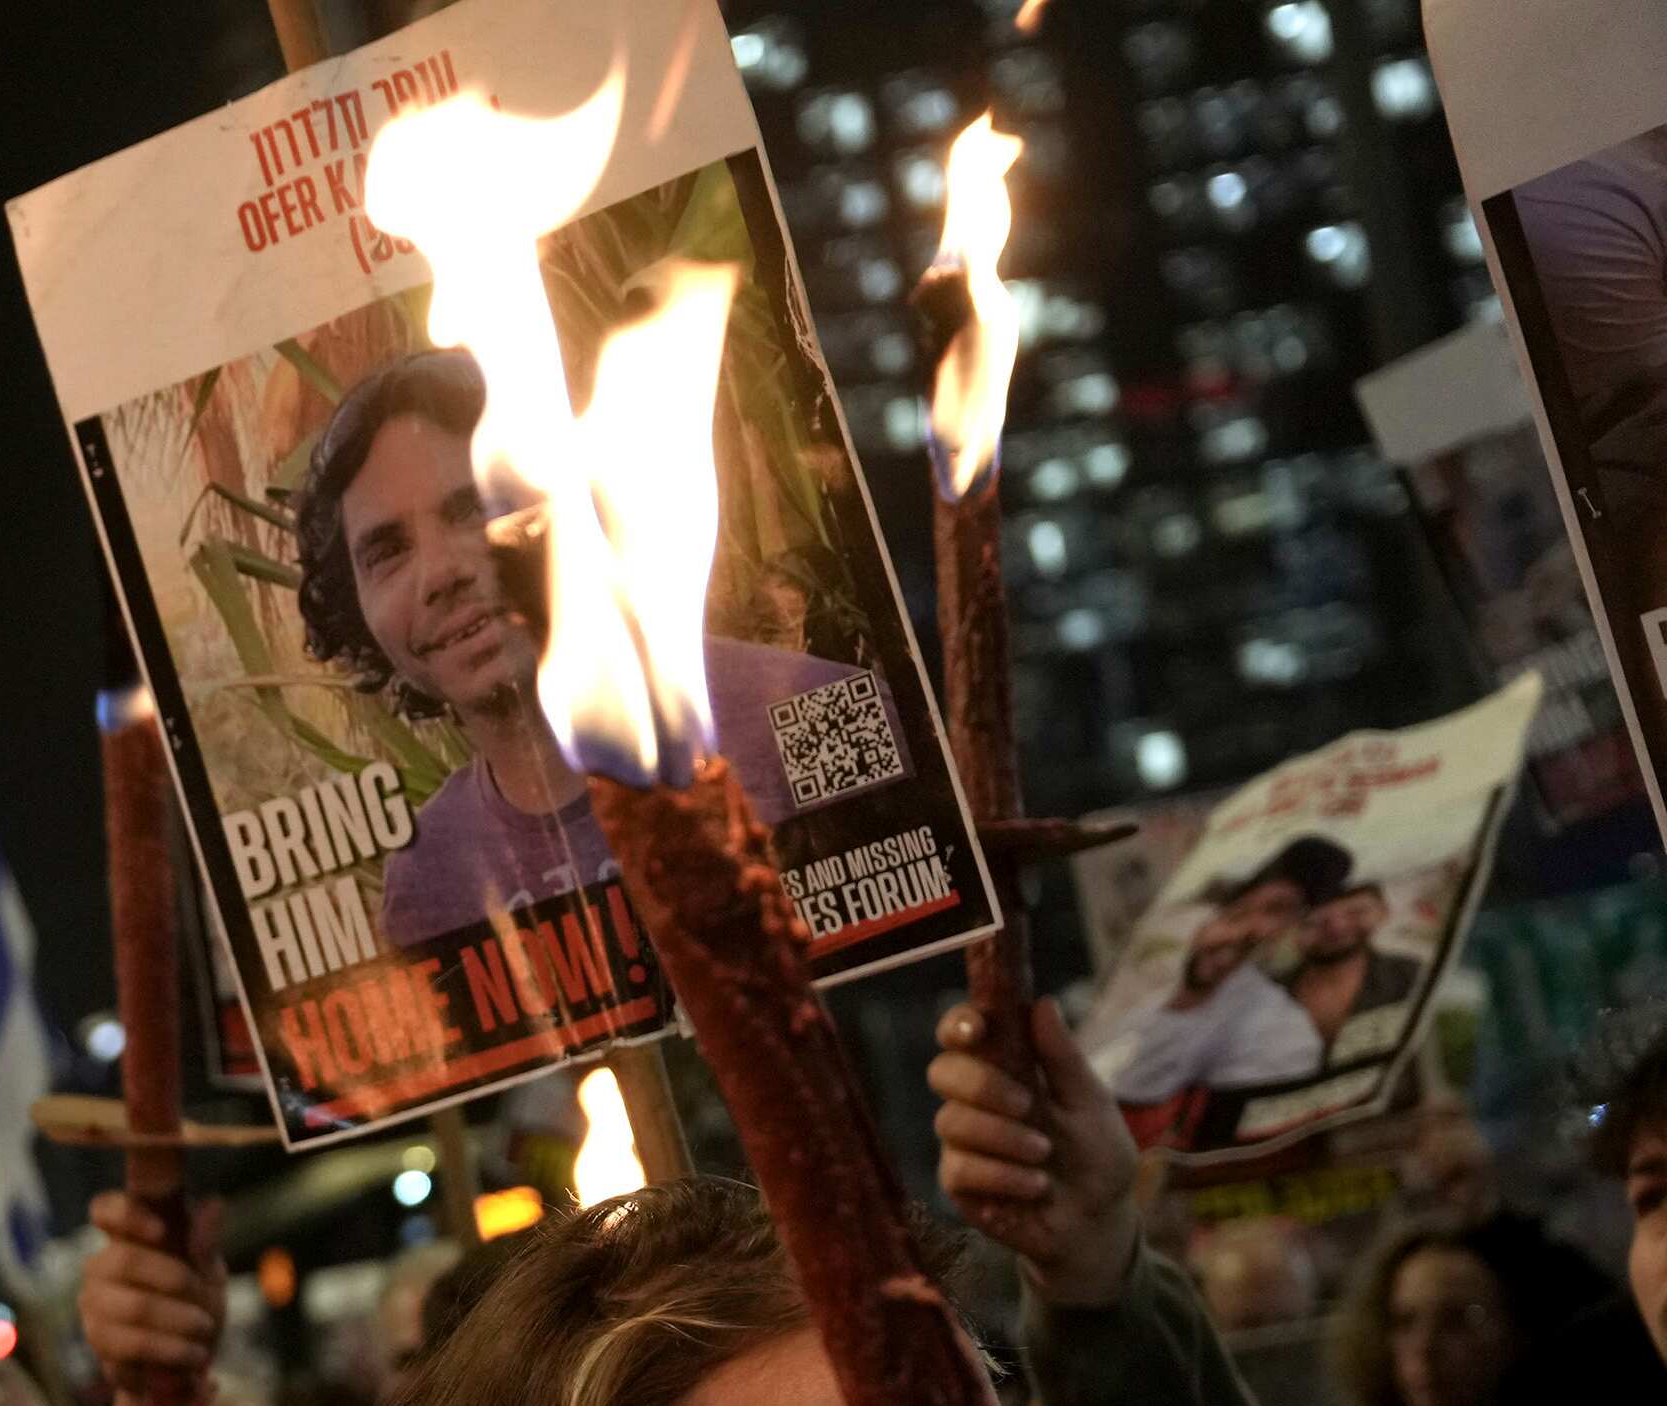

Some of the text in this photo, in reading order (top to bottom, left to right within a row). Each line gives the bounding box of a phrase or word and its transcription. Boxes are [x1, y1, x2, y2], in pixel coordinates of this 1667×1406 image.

[237, 173, 326, 253] OFER
[222, 761, 414, 901] BRING
[804, 855, 848, 894] AND
[844, 825, 937, 881] MISSING
[250, 875, 378, 992] HIM
[841, 854, 952, 928] FORUM
[281, 885, 647, 1090] HOME NOW!
